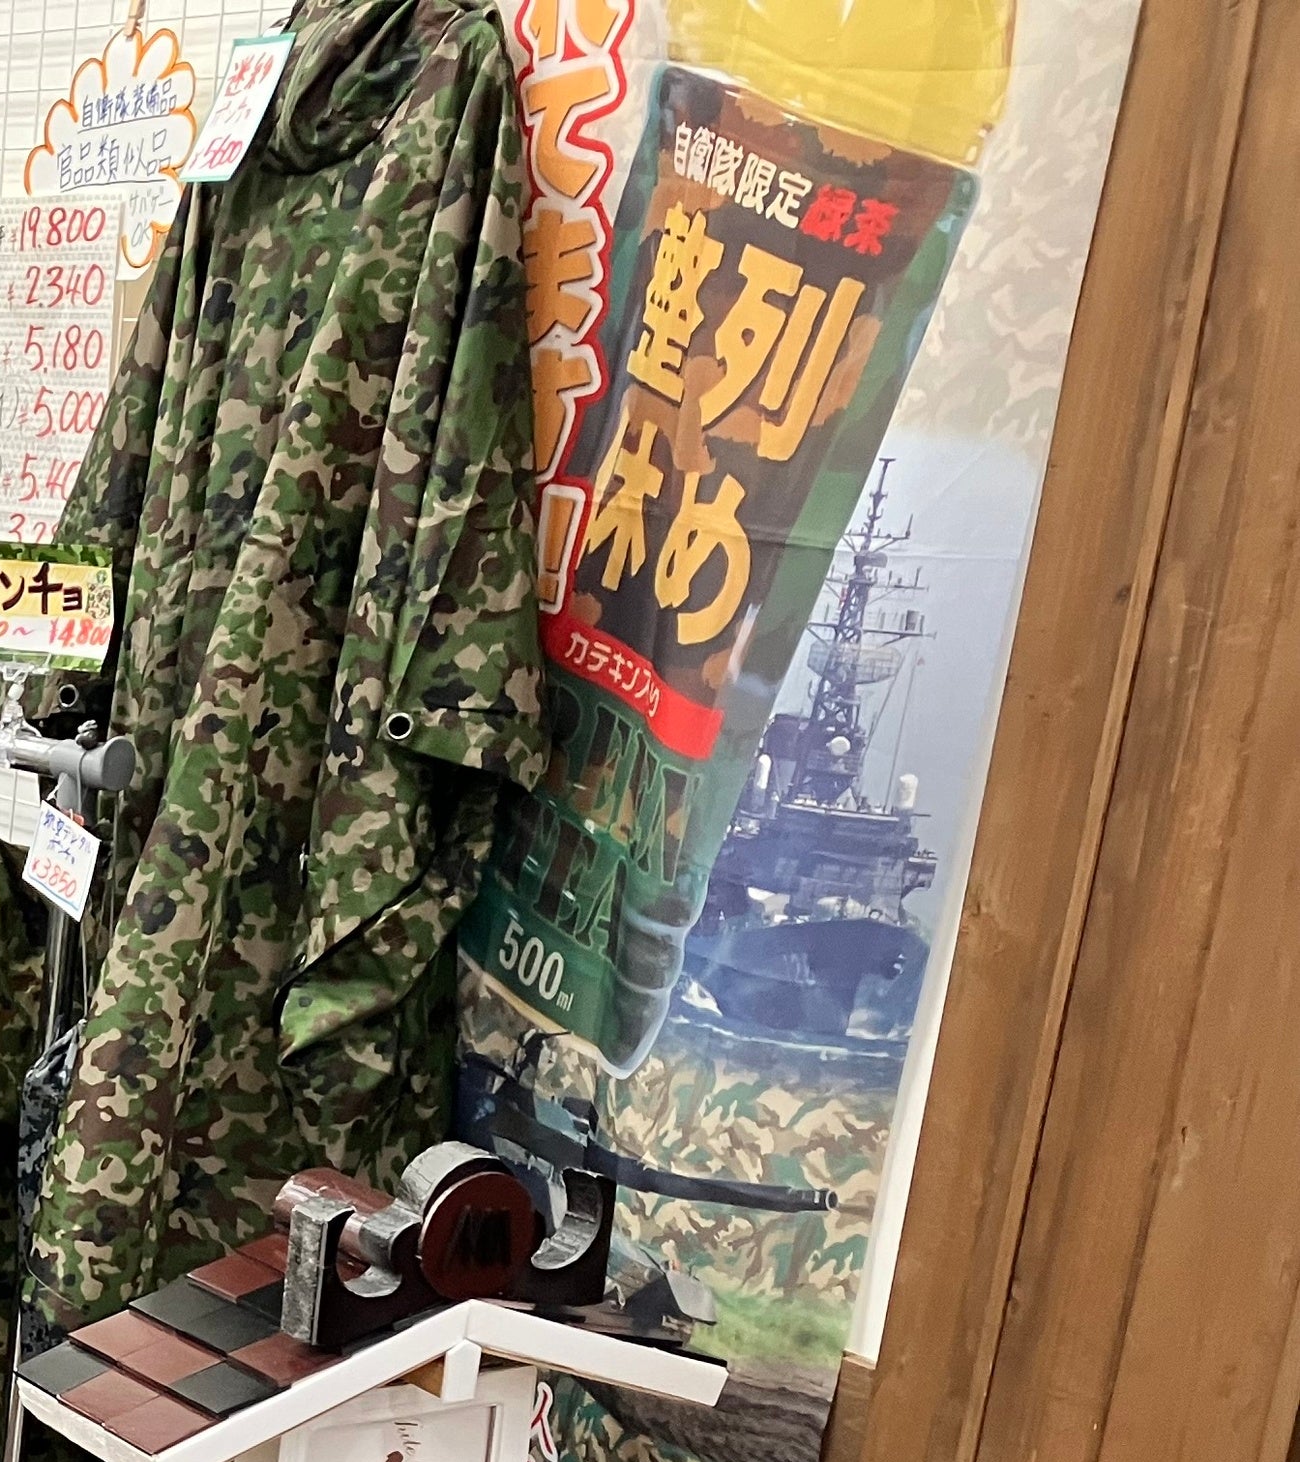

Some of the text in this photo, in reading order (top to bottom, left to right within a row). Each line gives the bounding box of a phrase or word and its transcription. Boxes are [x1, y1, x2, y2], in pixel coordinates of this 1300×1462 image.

[57, 129, 171, 189] 官品類似品
[132, 221, 150, 247] OK
[627, 202, 866, 463] 整列
[578, 403, 752, 646] 休め
[565, 630, 662, 719] カテキン入り
